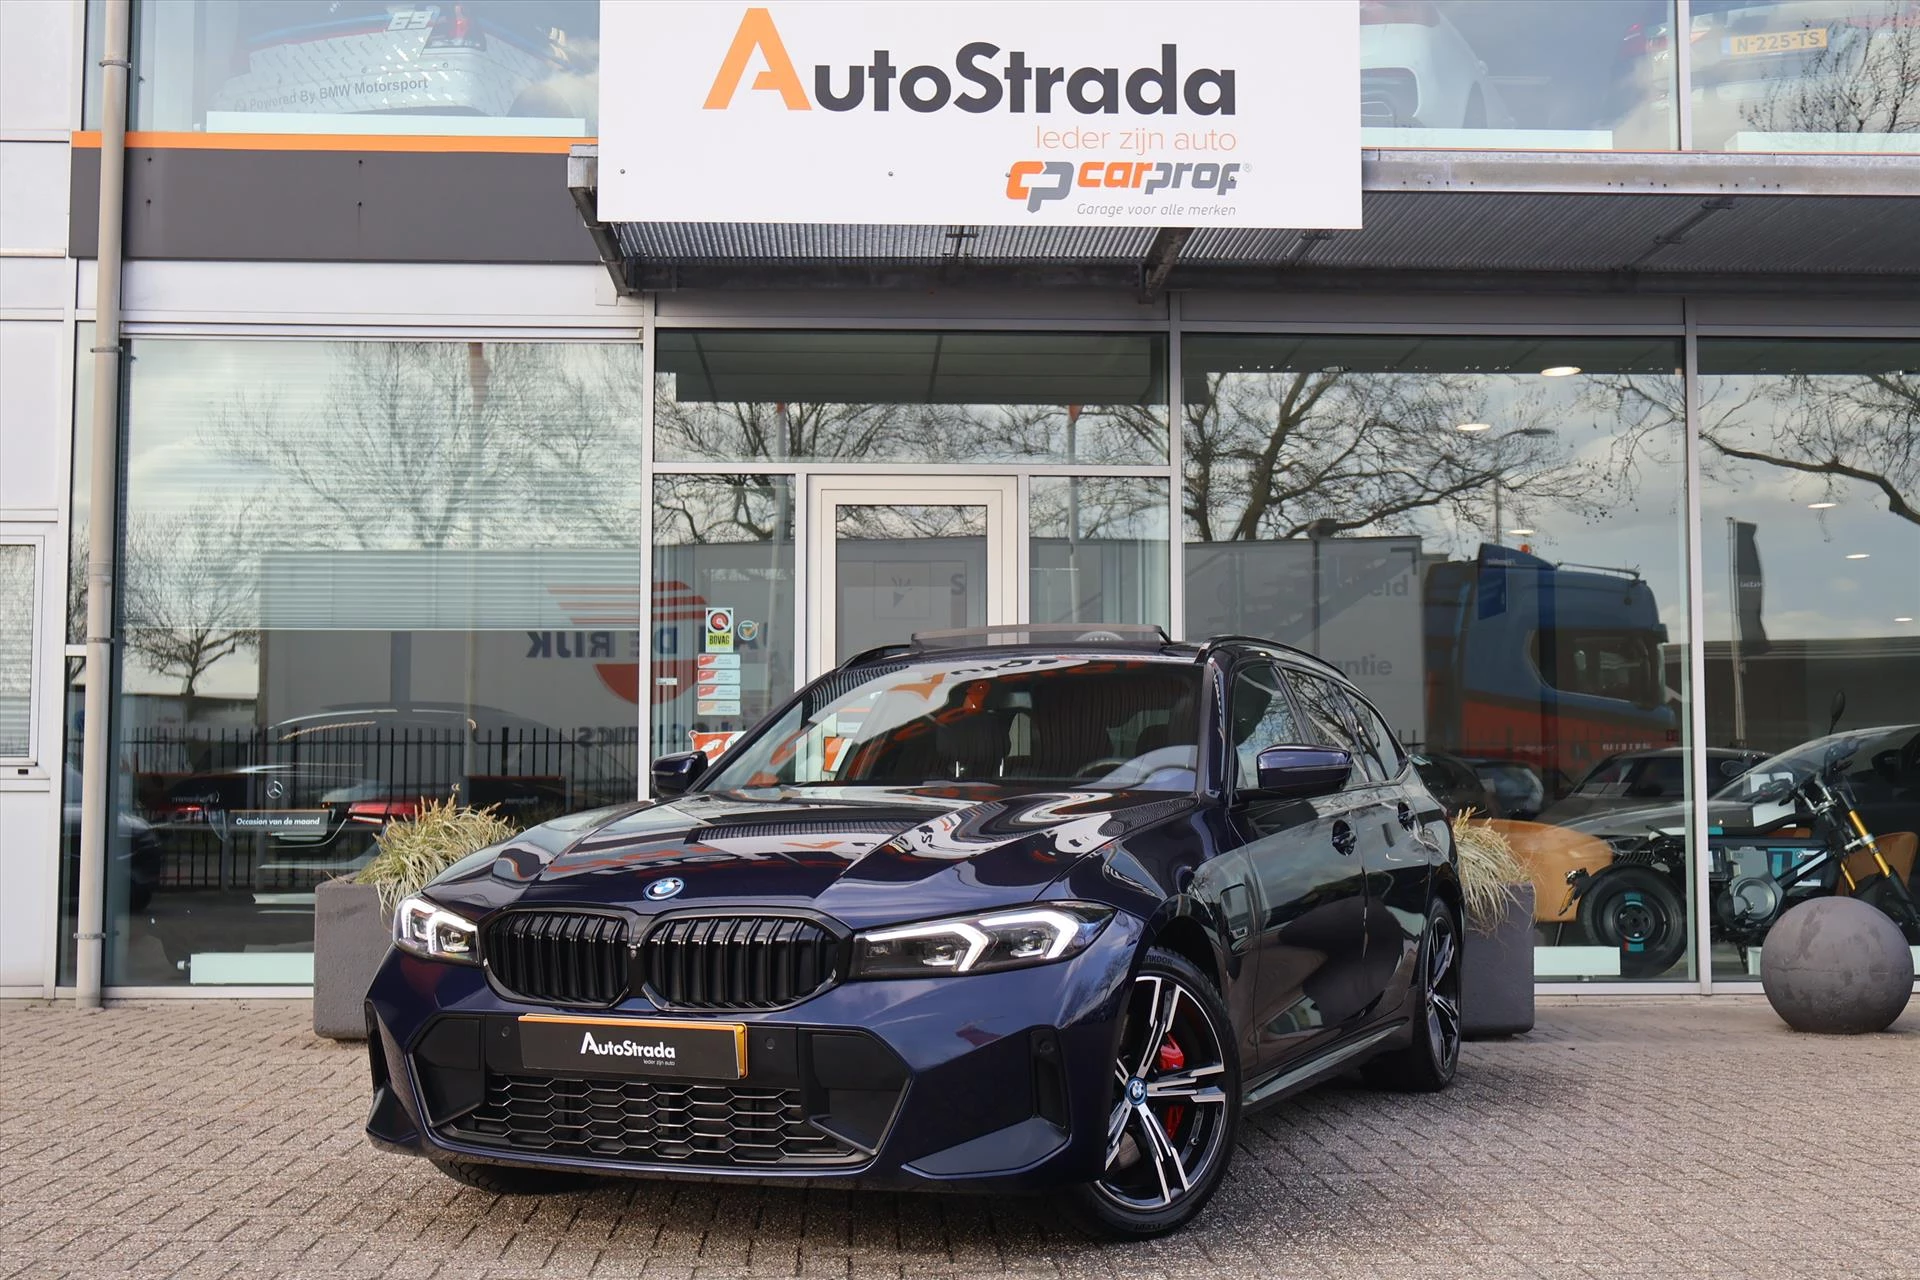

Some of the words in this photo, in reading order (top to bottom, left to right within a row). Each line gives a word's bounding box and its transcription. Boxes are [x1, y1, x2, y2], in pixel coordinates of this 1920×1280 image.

[1737, 31, 1820, 53] N-225-TS
[702, 7, 1237, 116] AutoStrada
[301, 89, 316, 105] By
[320, 84, 351, 99] BMW
[354, 77, 429, 96] Motorsport
[1036, 125, 1111, 150] Ieder
[1119, 127, 1164, 156] zijn
[1174, 128, 1237, 151] auto
[1077, 161, 1241, 196] carprof
[1077, 203, 1124, 218] Garage
[1128, 205, 1158, 216] voor
[1160, 203, 1185, 216] alle
[1188, 203, 1237, 216] merken
[709, 634, 730, 646] BOVAG
[236, 817, 267, 826] Occasion
[268, 818, 282, 826] van
[283, 817, 293, 826] de
[294, 816, 320, 826] maand
[580, 1031, 676, 1059] AutoStrada
